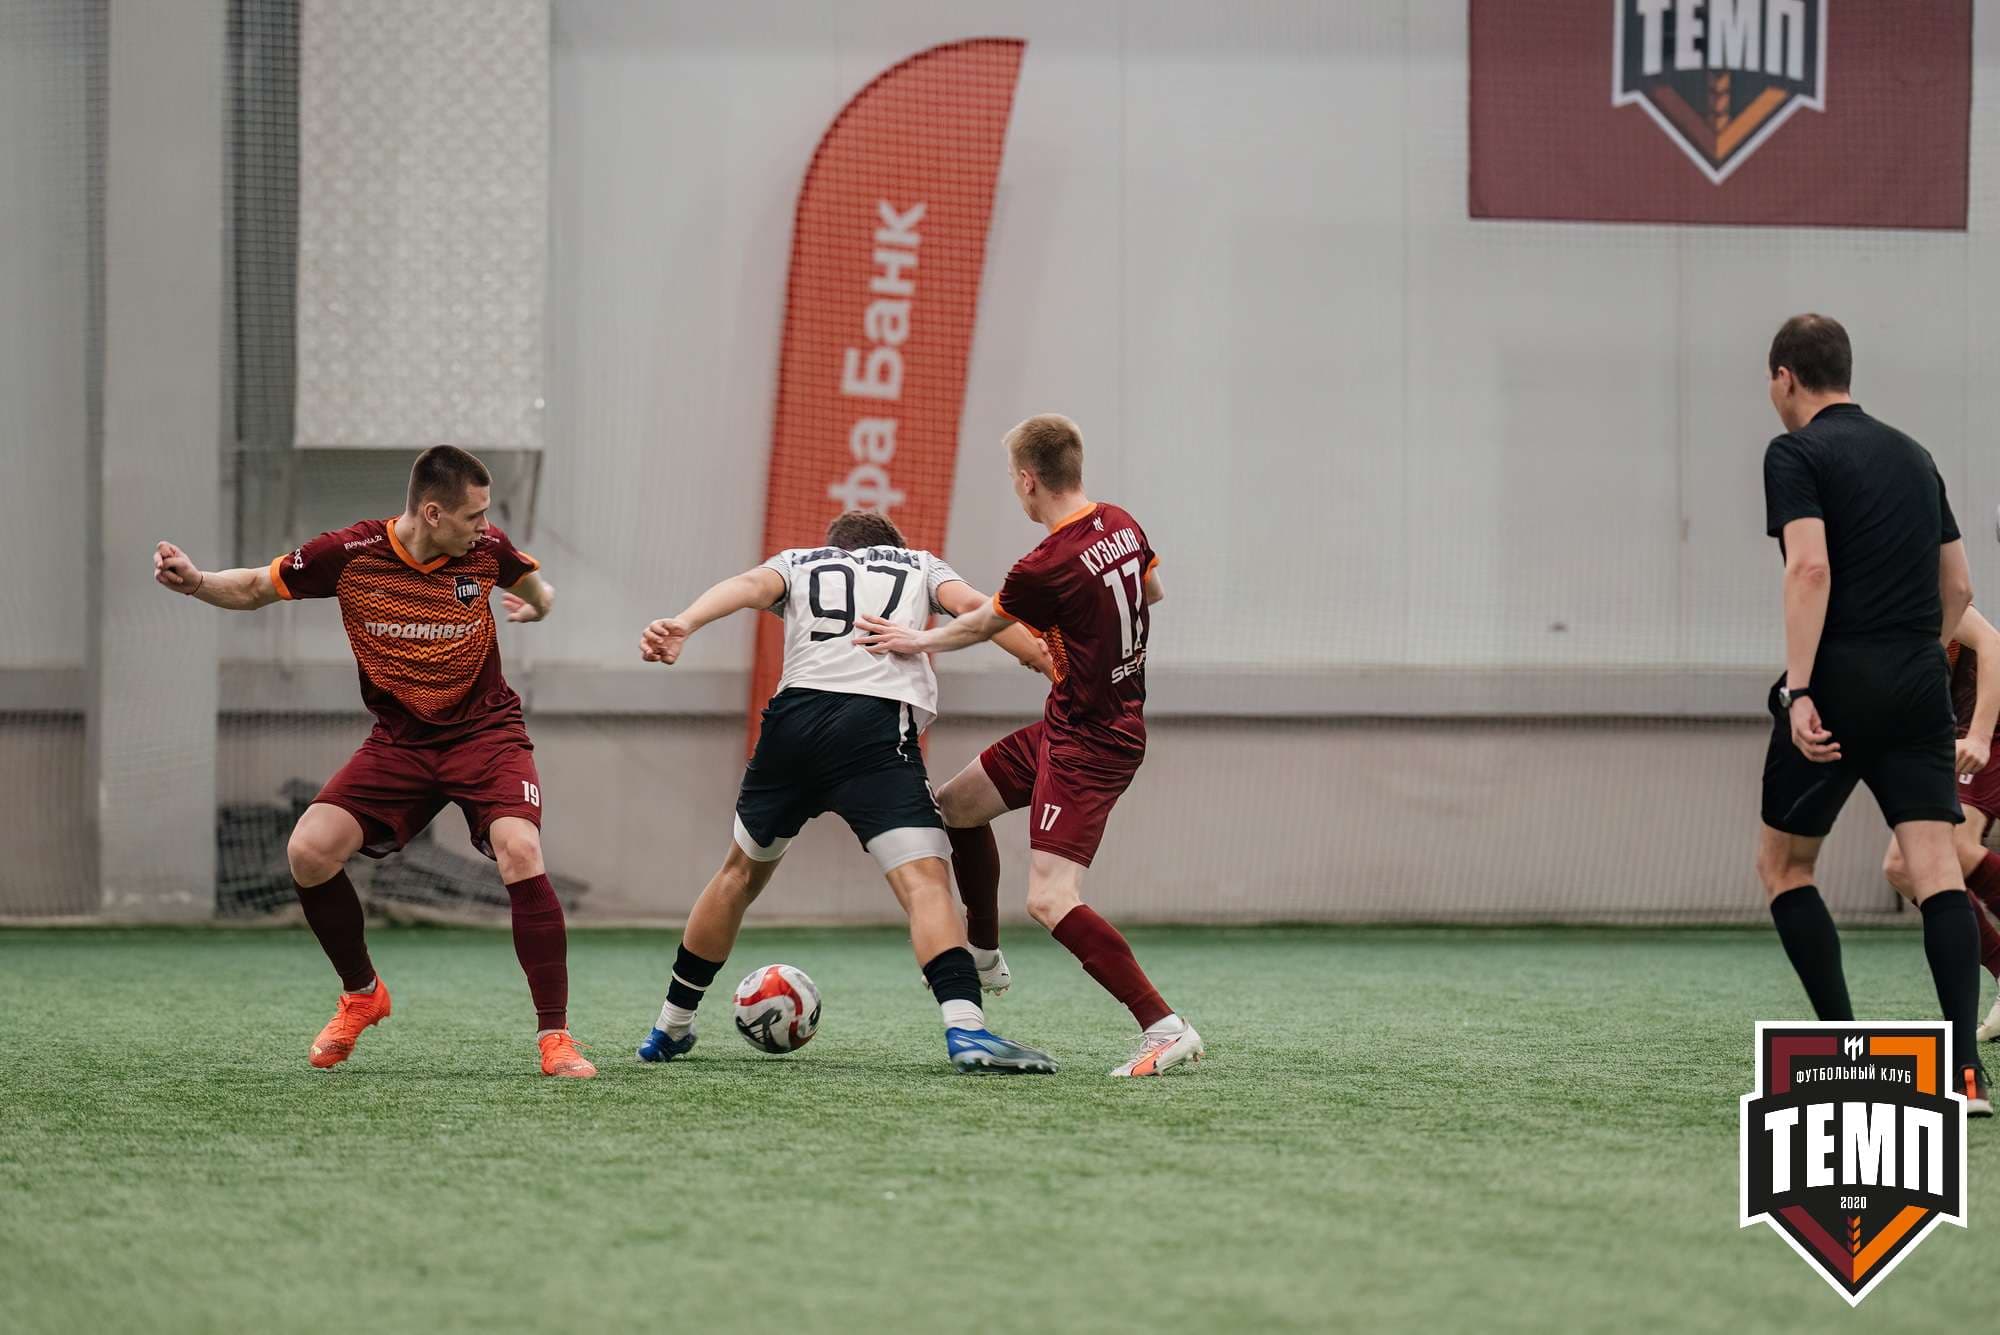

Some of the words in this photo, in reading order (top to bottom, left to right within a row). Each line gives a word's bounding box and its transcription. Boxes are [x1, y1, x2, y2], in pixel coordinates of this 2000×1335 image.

[1637, 0, 1805, 80] ТЕМП
[841, 200, 927, 399] Банк
[1079, 527, 1141, 577] КУЗЬКИН
[456, 583, 480, 599] ТЕМП
[809, 563, 909, 647] 97
[1102, 556, 1144, 660] 17
[521, 780, 540, 808] 19
[1040, 803, 1062, 831] 17
